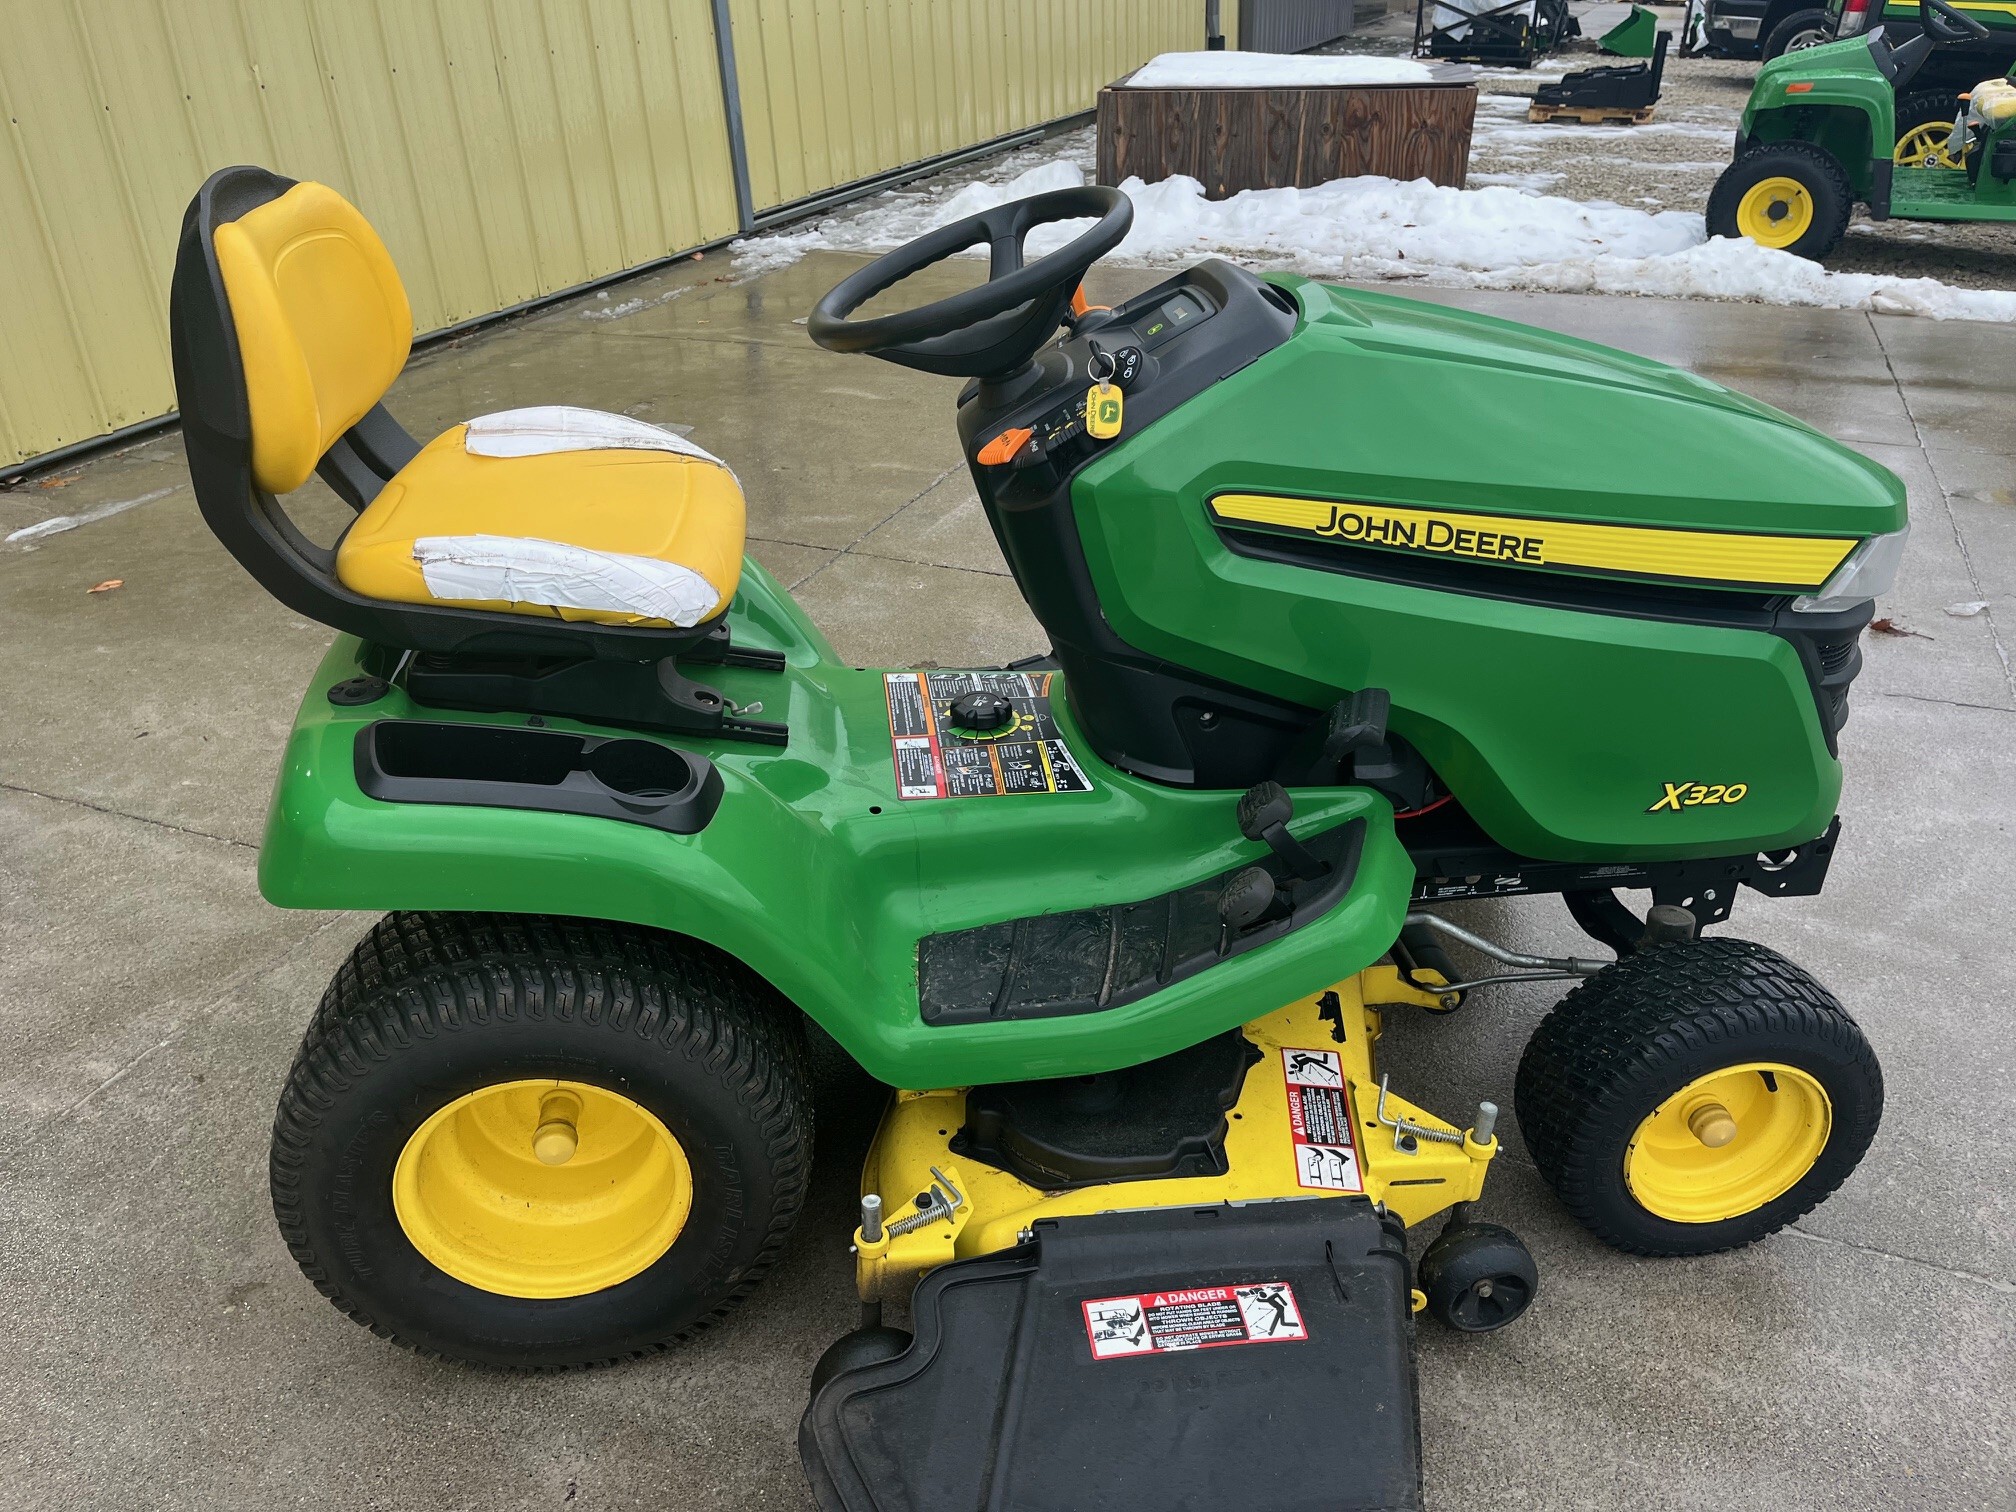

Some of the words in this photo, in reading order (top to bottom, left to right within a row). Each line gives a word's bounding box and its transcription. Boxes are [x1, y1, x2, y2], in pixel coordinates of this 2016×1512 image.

[1316, 506, 1417, 545] JOHN
[1425, 519, 1544, 562] DEERE
[1645, 782, 1748, 813] X320
[1289, 1091, 1302, 1126] DANGER
[690, 1145, 743, 1292] CARLISLE
[1167, 1290, 1228, 1303] DANGER
